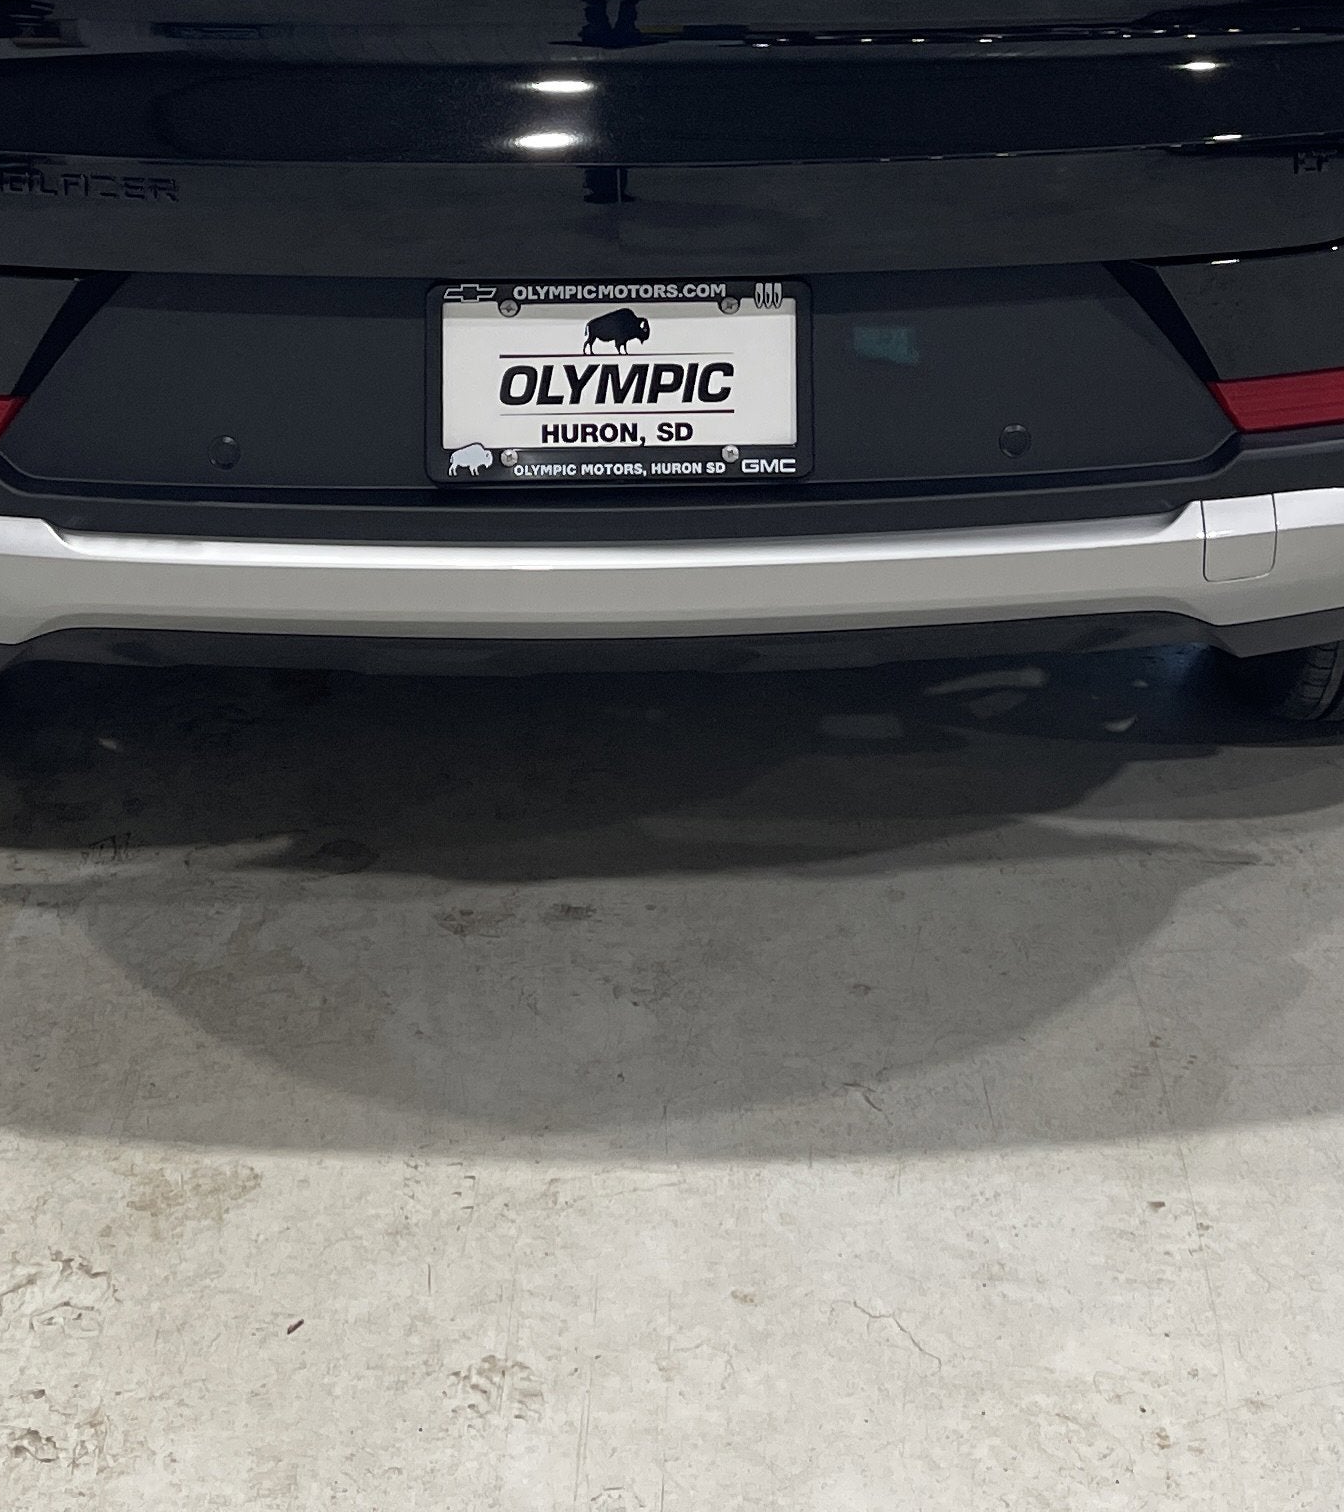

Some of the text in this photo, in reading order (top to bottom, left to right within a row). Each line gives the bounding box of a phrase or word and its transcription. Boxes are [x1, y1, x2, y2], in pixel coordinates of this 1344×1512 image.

[513, 284, 726, 300] OLYMPICMOTORS.COM
[499, 362, 735, 406] OLYMPIC
[541, 421, 694, 446] HURON, SD
[514, 461, 726, 478] OLYMPIC MOTORS, HURON SD
[741, 459, 796, 473] GMC
